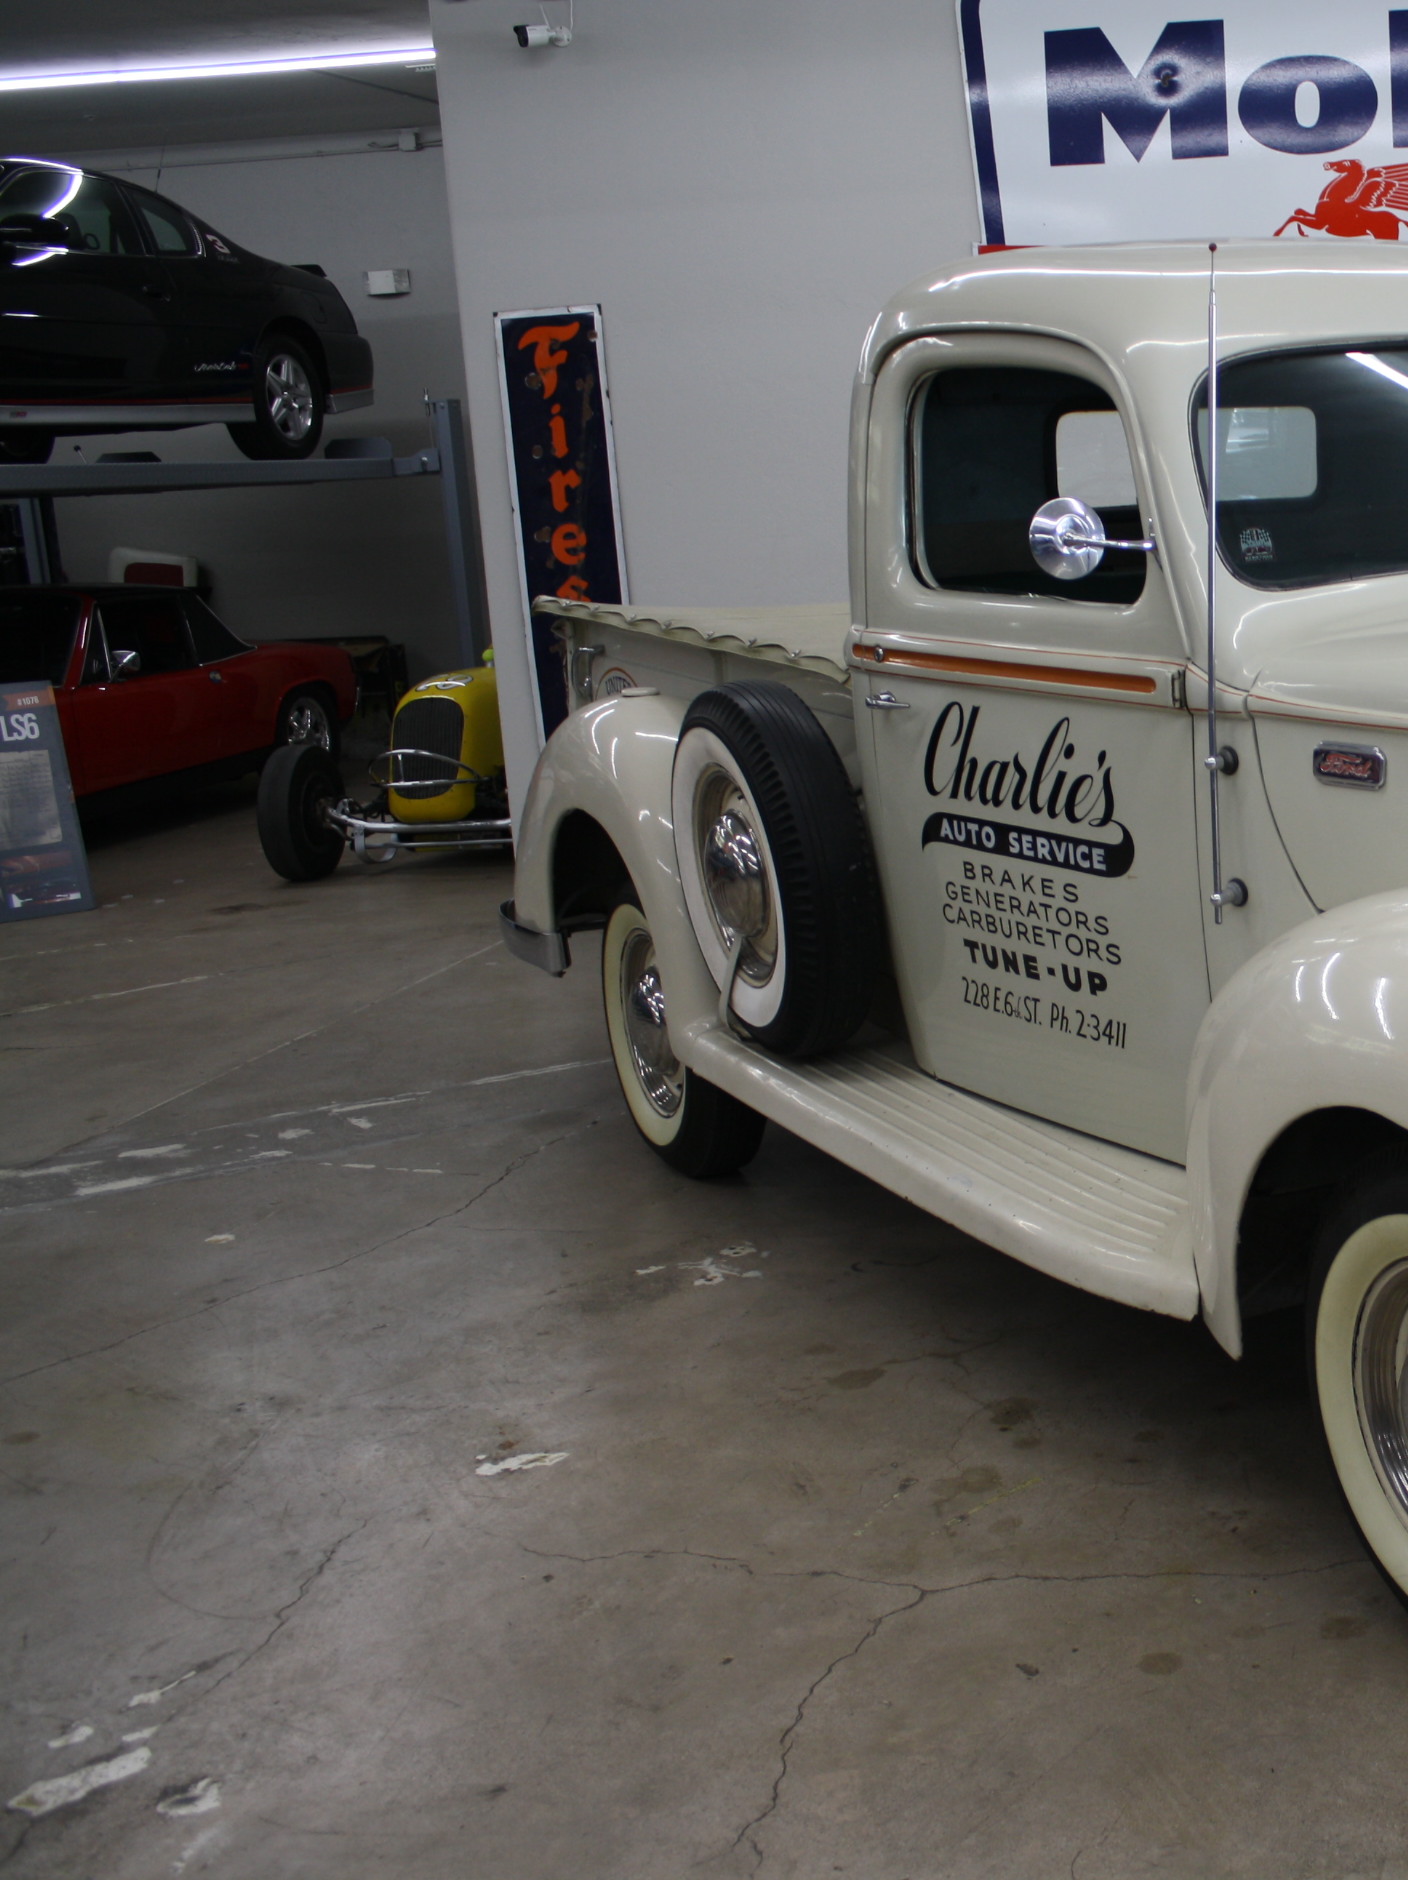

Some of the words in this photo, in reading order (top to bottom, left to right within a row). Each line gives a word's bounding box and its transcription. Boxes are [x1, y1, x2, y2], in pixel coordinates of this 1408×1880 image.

[205, 233, 232, 255] 3
[0, 712, 40, 742] LS6
[924, 701, 1115, 828] Charlie's
[1319, 753, 1372, 779] Ford
[940, 817, 996, 849] AUTO
[1008, 831, 1107, 872] SERVICE
[945, 881, 1109, 936] GENERATORS
[963, 861, 1079, 903] BRAKES
[942, 903, 1122, 966] CARBURETORS
[963, 938, 1108, 997] TUNE-UP
[962, 976, 990, 1010] 228
[1050, 1002, 1072, 1034] Ph.
